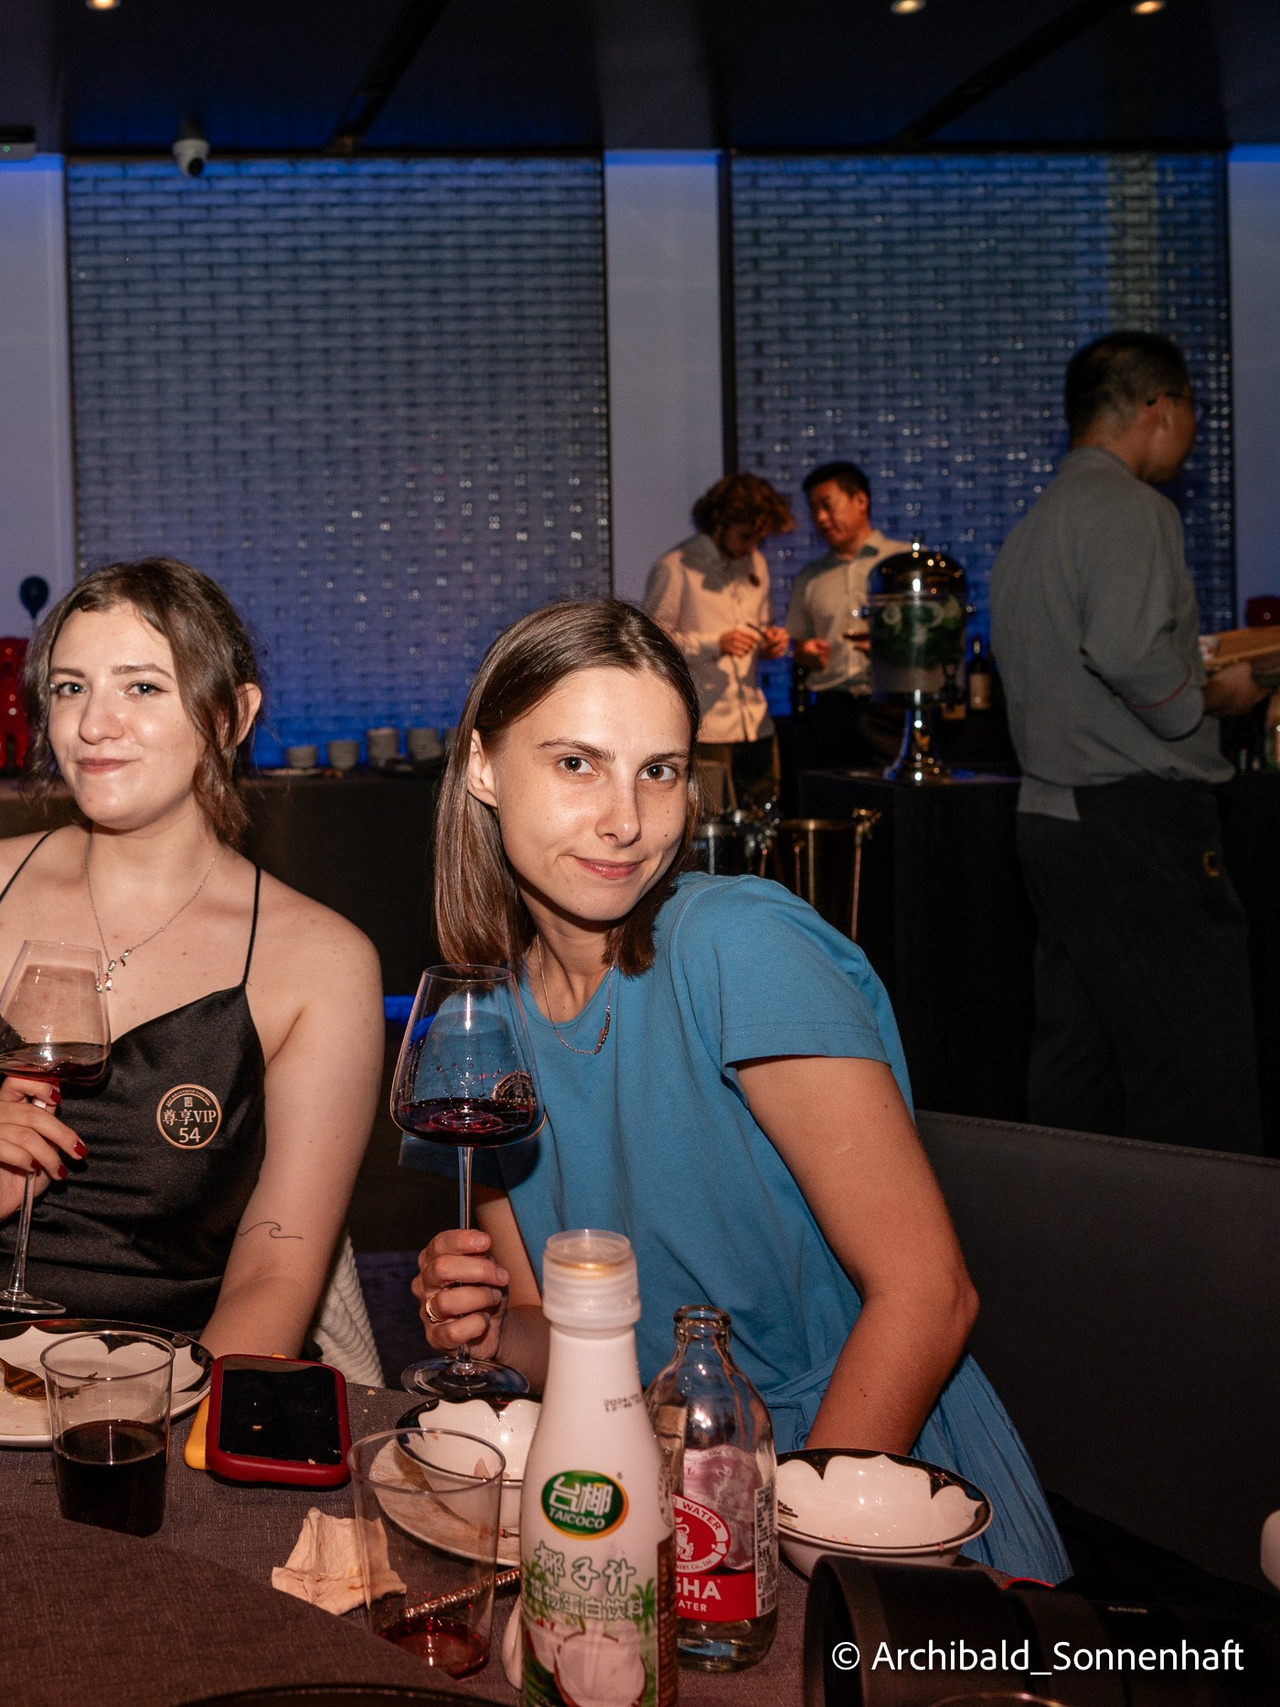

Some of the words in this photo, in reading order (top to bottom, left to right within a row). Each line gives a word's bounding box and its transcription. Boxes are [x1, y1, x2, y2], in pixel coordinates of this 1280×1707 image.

[179, 1127, 201, 1143] 54
[548, 1506, 606, 1530] TAICOCO
[682, 1501, 722, 1531] WATER
[534, 1540, 637, 1597] 椰子汁
[678, 1599, 708, 1612] ATER
